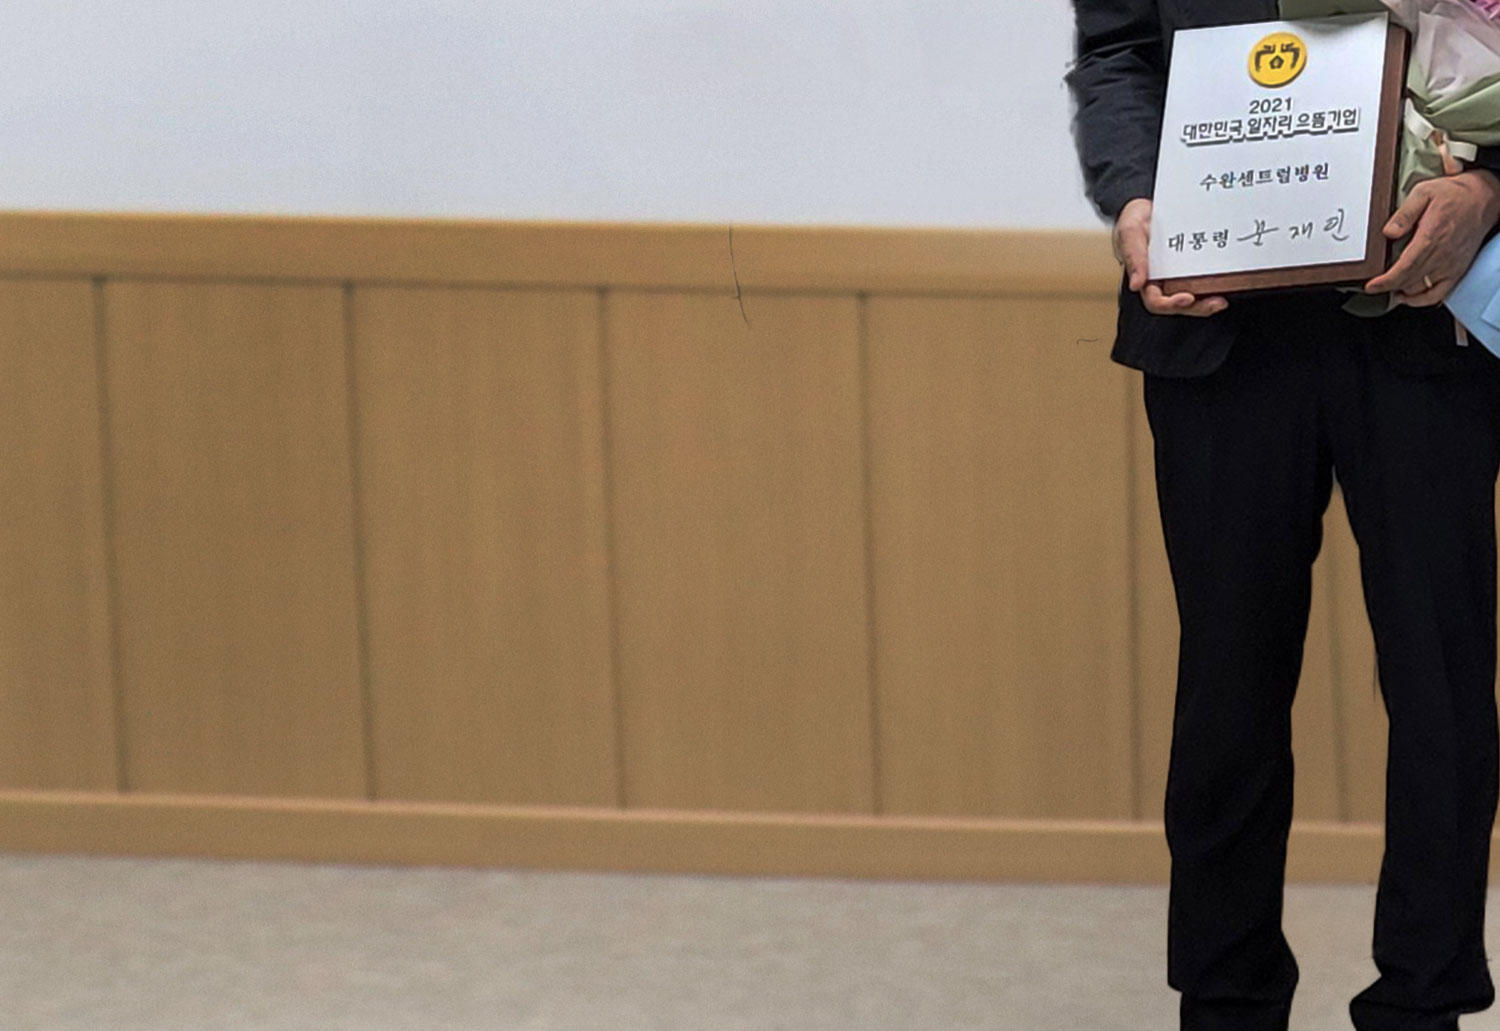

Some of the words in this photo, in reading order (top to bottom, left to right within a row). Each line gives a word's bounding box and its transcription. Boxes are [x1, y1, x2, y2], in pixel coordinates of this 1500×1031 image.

[1249, 97, 1293, 115] 2021
[1182, 118, 1244, 142] 대한민국
[1246, 113, 1293, 135] 일자리
[1295, 107, 1358, 130] 으뜸기업
[1200, 162, 1330, 191] 수완센트럴병원
[1168, 229, 1230, 253] 대통령
